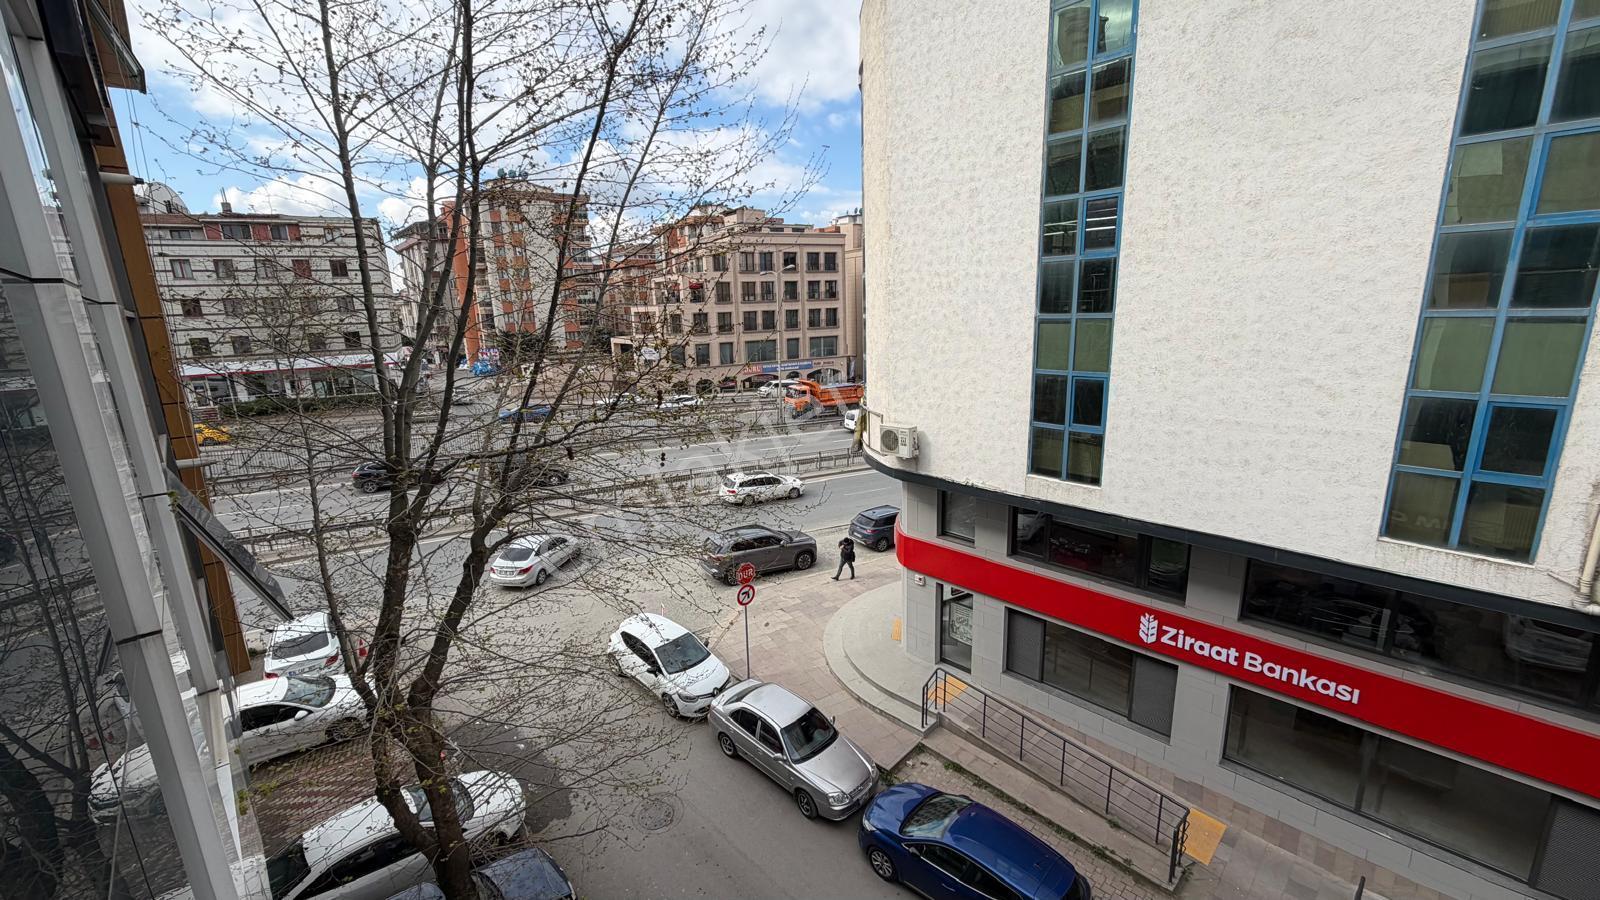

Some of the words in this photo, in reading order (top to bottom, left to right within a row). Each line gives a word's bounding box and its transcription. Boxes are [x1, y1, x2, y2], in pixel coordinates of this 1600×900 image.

[737, 568, 753, 580] DUR
[1161, 625, 1238, 666] Ziraat
[1243, 652, 1360, 704] Bankası
